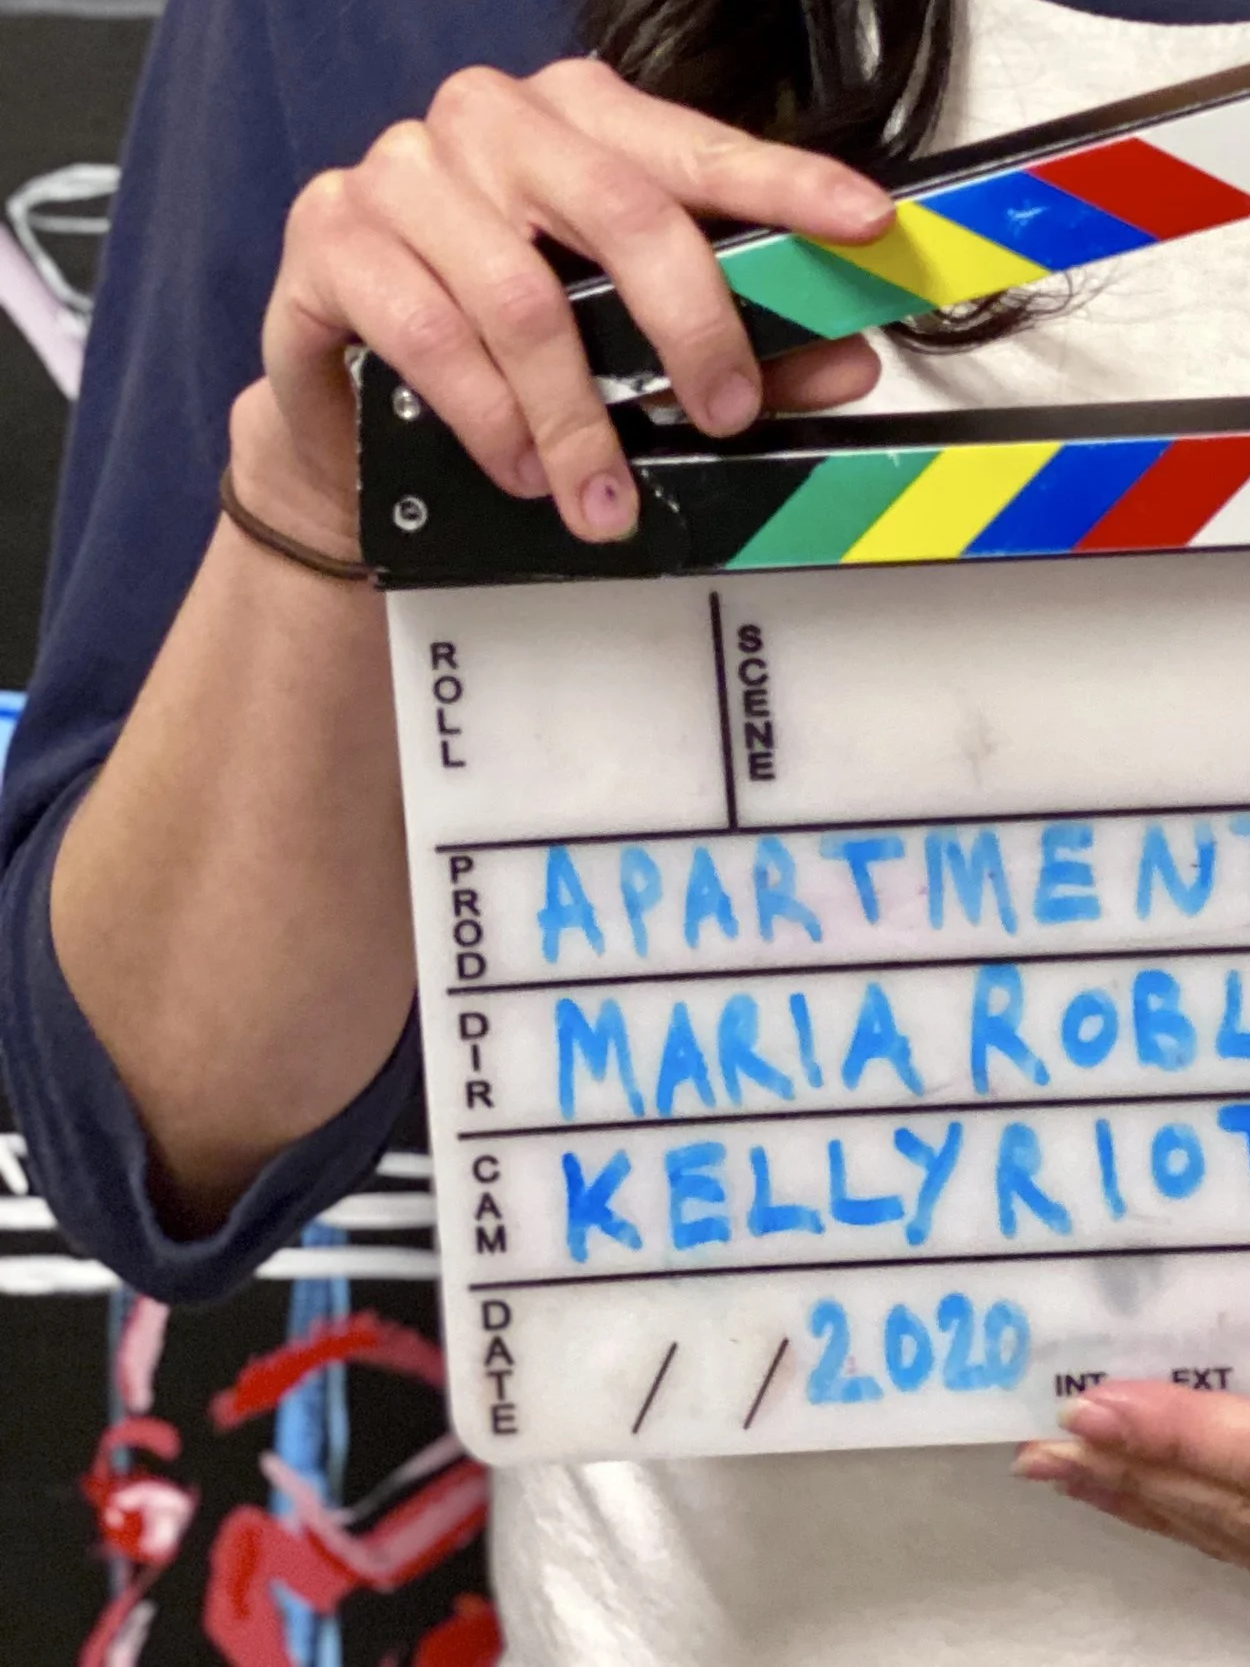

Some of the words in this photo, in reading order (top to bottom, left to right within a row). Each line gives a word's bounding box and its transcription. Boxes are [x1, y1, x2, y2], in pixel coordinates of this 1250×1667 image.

[429, 641, 466, 768] ROLL
[737, 623, 776, 781] SCENE
[449, 854, 487, 981] PROD
[459, 1011, 494, 1109] DIR
[555, 983, 924, 1119] MARIA
[472, 1154, 507, 1254] CAM
[481, 1299, 518, 1434] DATE
[806, 1291, 1031, 1405] 2020
